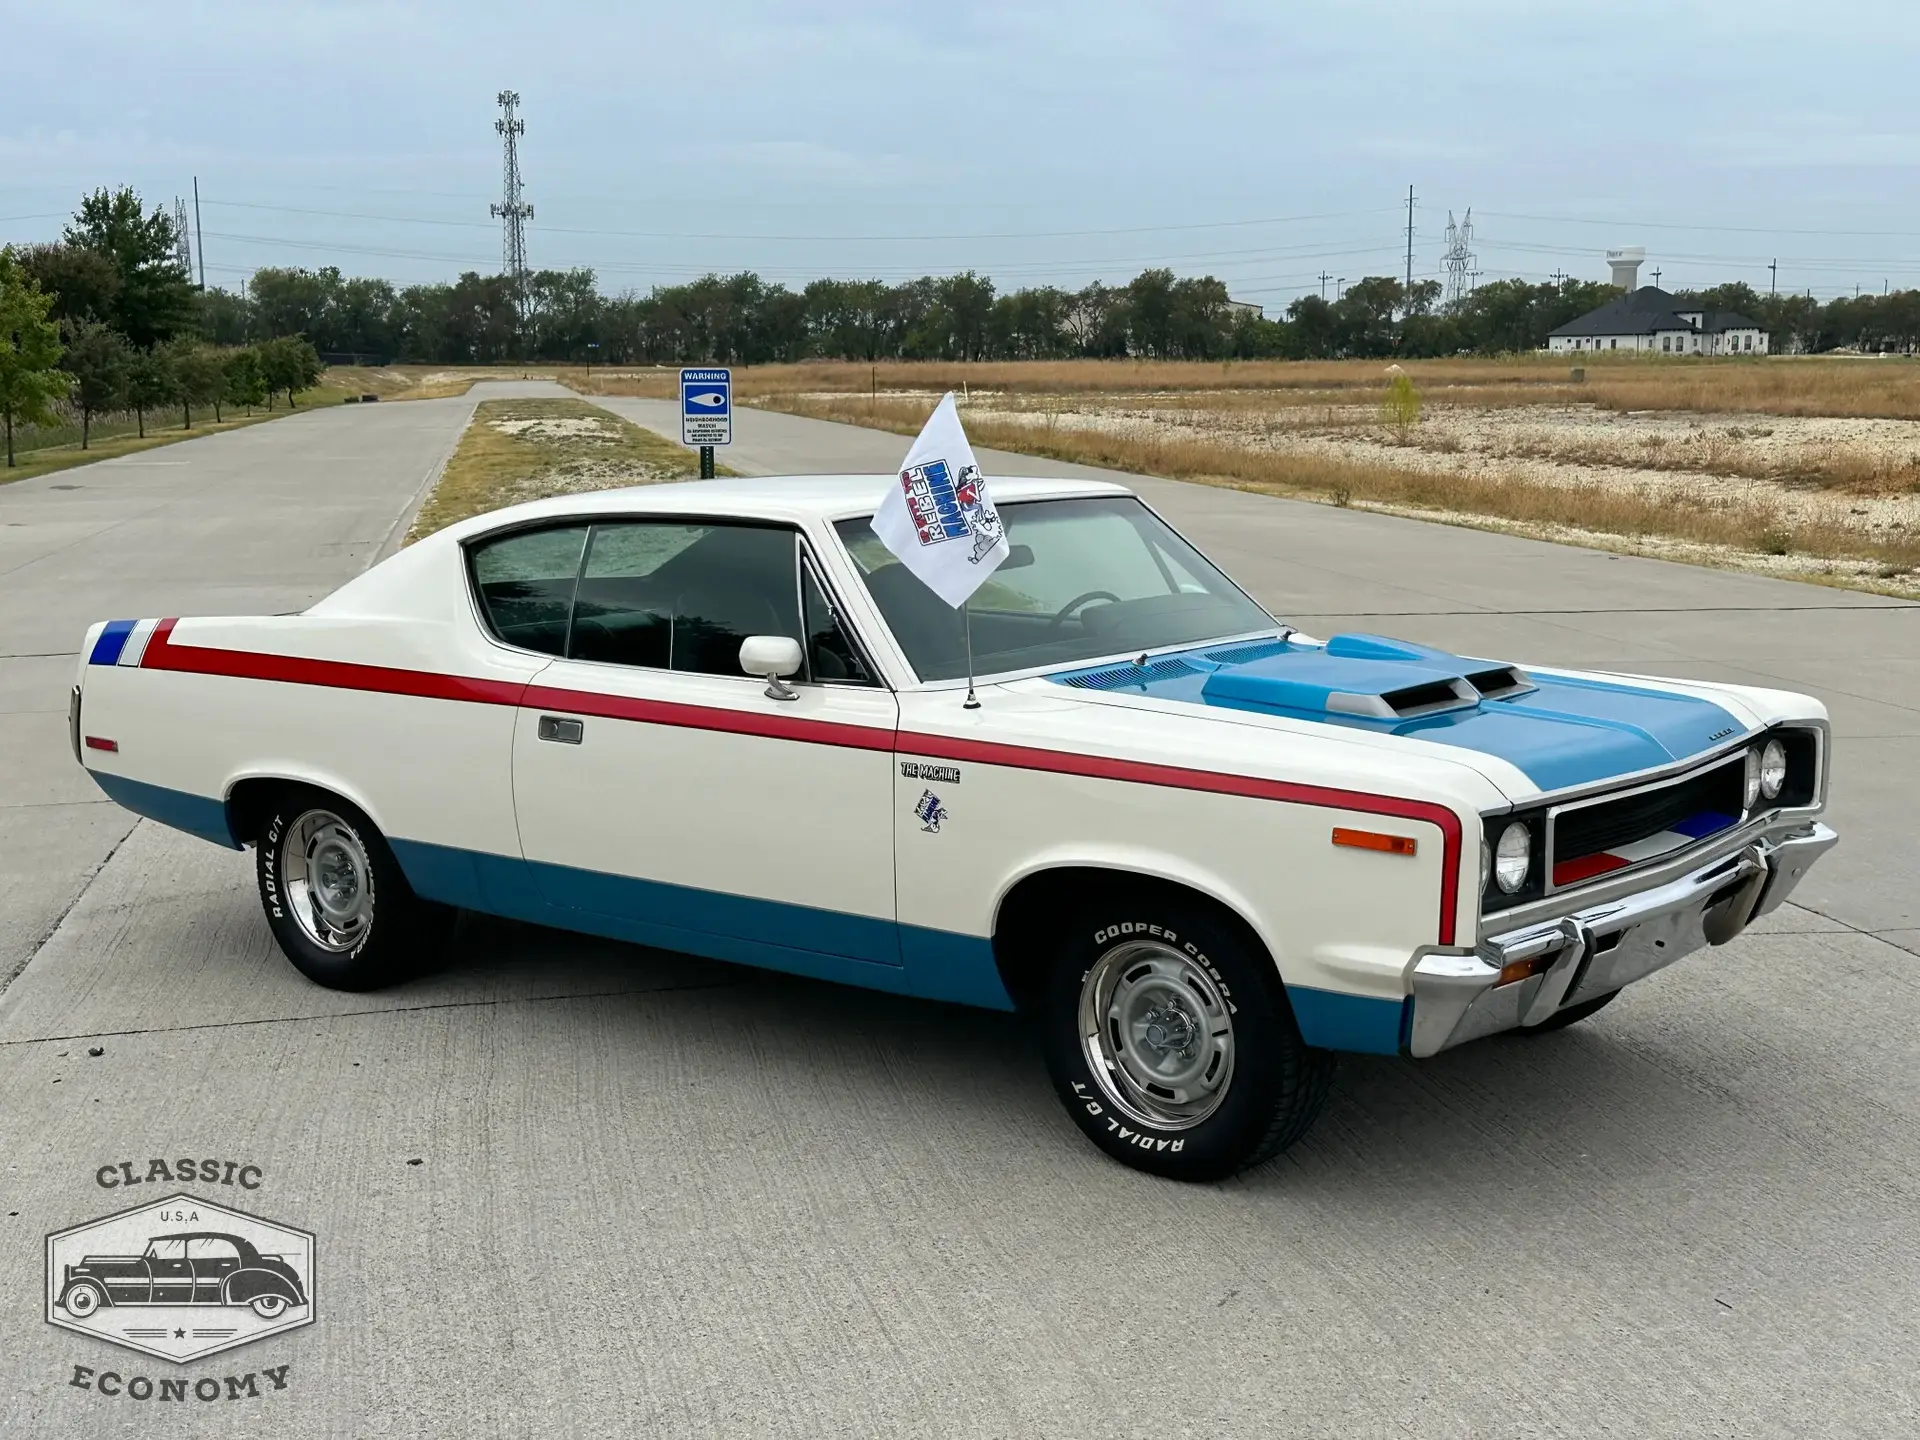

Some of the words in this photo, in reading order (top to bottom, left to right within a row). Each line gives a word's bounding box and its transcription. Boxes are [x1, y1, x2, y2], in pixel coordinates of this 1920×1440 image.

[684, 372, 727, 380] WARNING
[910, 467, 946, 541] REBEL
[922, 461, 969, 538] MACHINE
[900, 762, 918, 778] THE
[919, 764, 960, 784] MACHINE
[268, 815, 284, 843] G/T
[265, 849, 283, 918] RADIAL
[1094, 922, 1177, 944] COOPER
[1184, 942, 1238, 1014] COBRA
[1071, 1080, 1103, 1116] G/T
[1107, 1116, 1185, 1152] RADIAL
